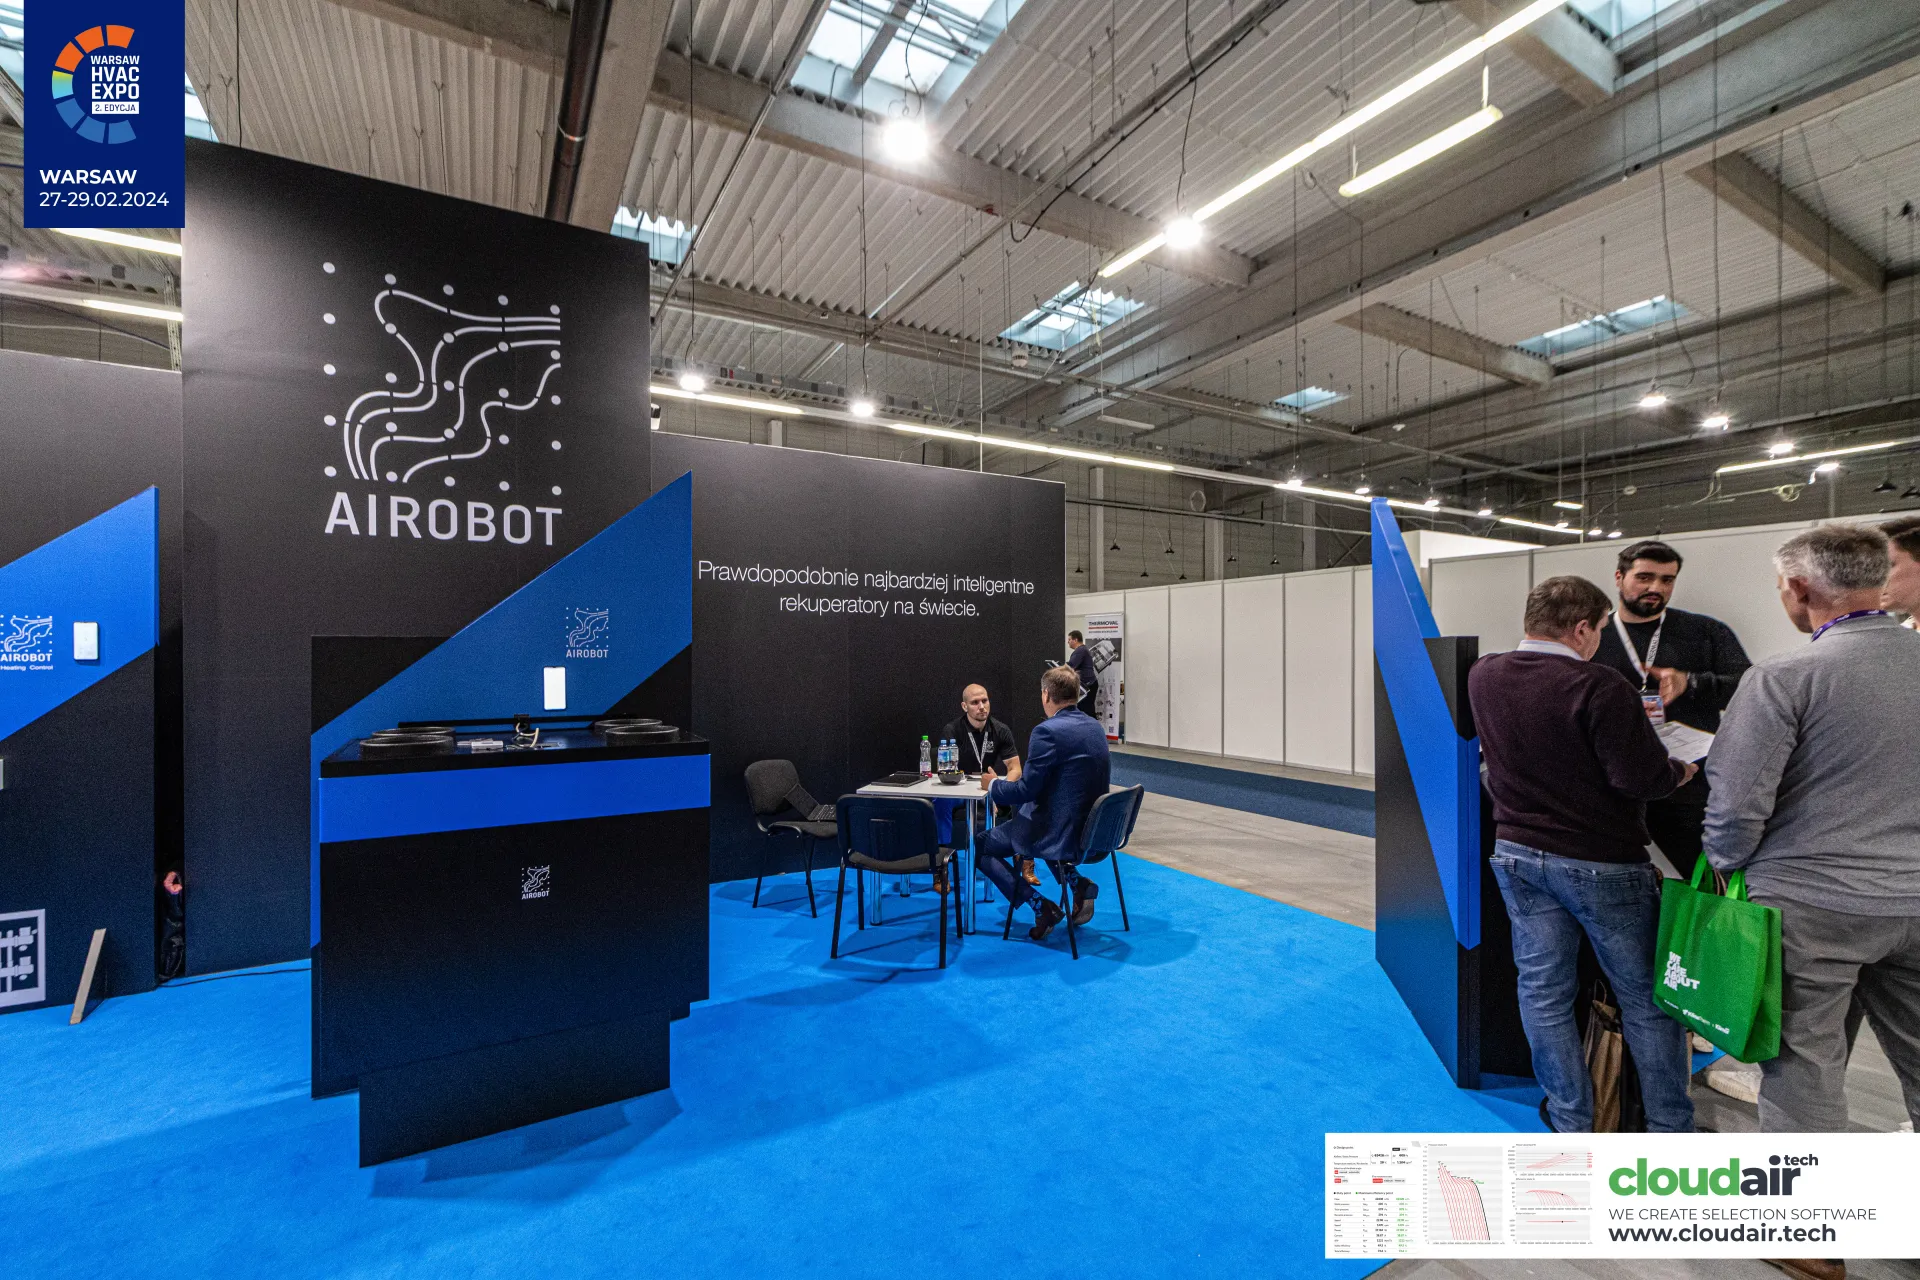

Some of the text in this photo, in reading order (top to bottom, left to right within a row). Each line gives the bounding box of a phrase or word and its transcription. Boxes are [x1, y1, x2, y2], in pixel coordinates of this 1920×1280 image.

[324, 491, 563, 546] AIROBOT
[698, 560, 1035, 597] Prawdopodobnie najbardziej inteligentne
[779, 593, 981, 618] rekuperatory na świecie.
[0, 653, 53, 662] AIROBOT
[565, 649, 609, 659] AIROBOT
[521, 890, 550, 900] AIROBOT
